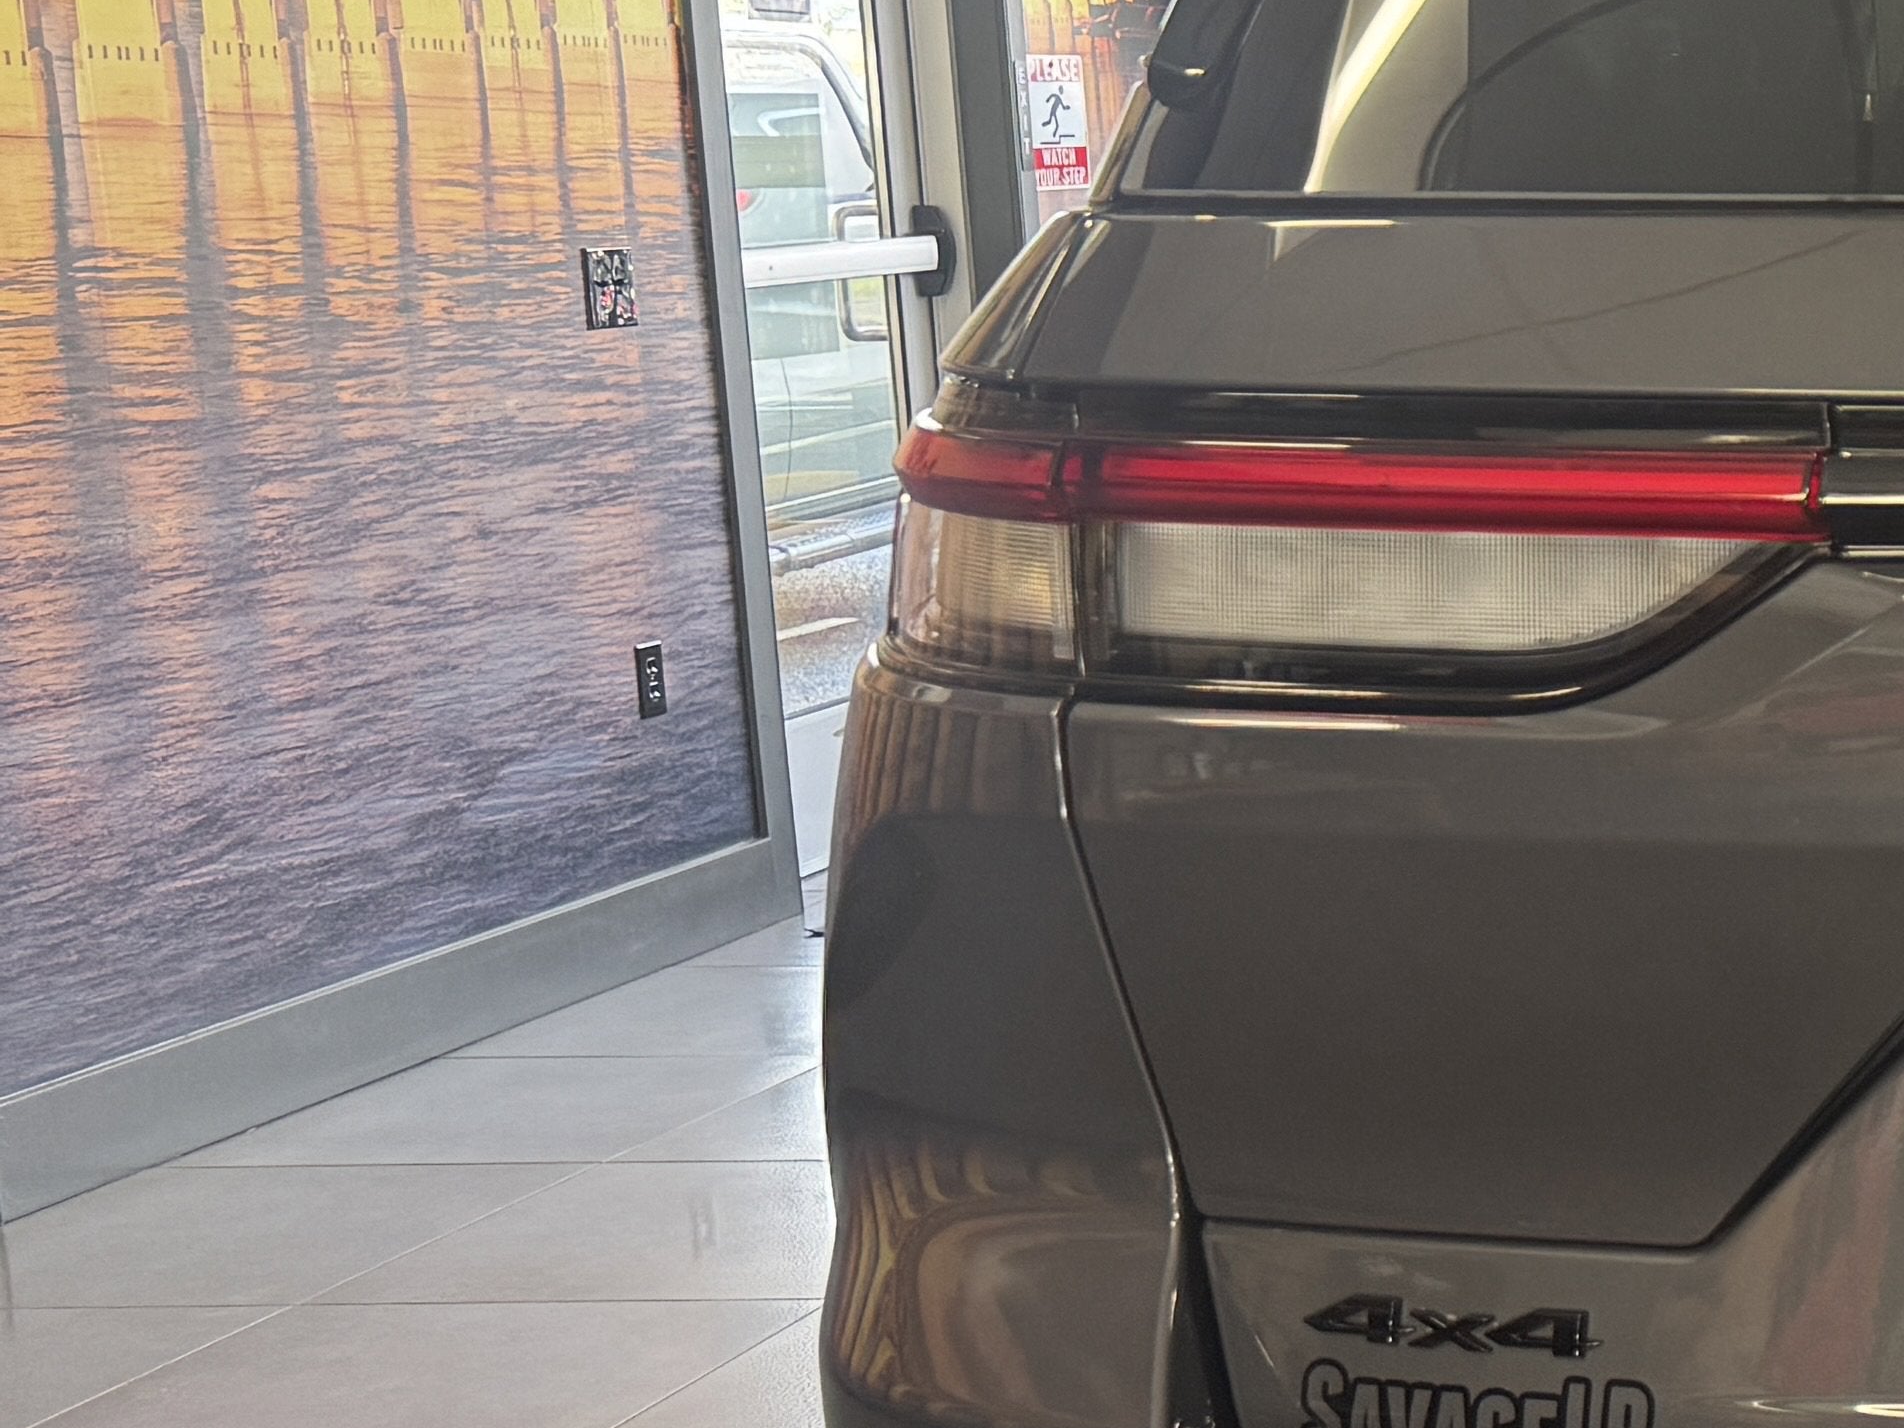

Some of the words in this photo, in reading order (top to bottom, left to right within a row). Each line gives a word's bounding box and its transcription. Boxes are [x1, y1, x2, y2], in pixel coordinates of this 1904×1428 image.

[1029, 58, 1079, 82] PLEASE
[1041, 148, 1076, 166] WATCH
[1063, 166, 1087, 186] STEP
